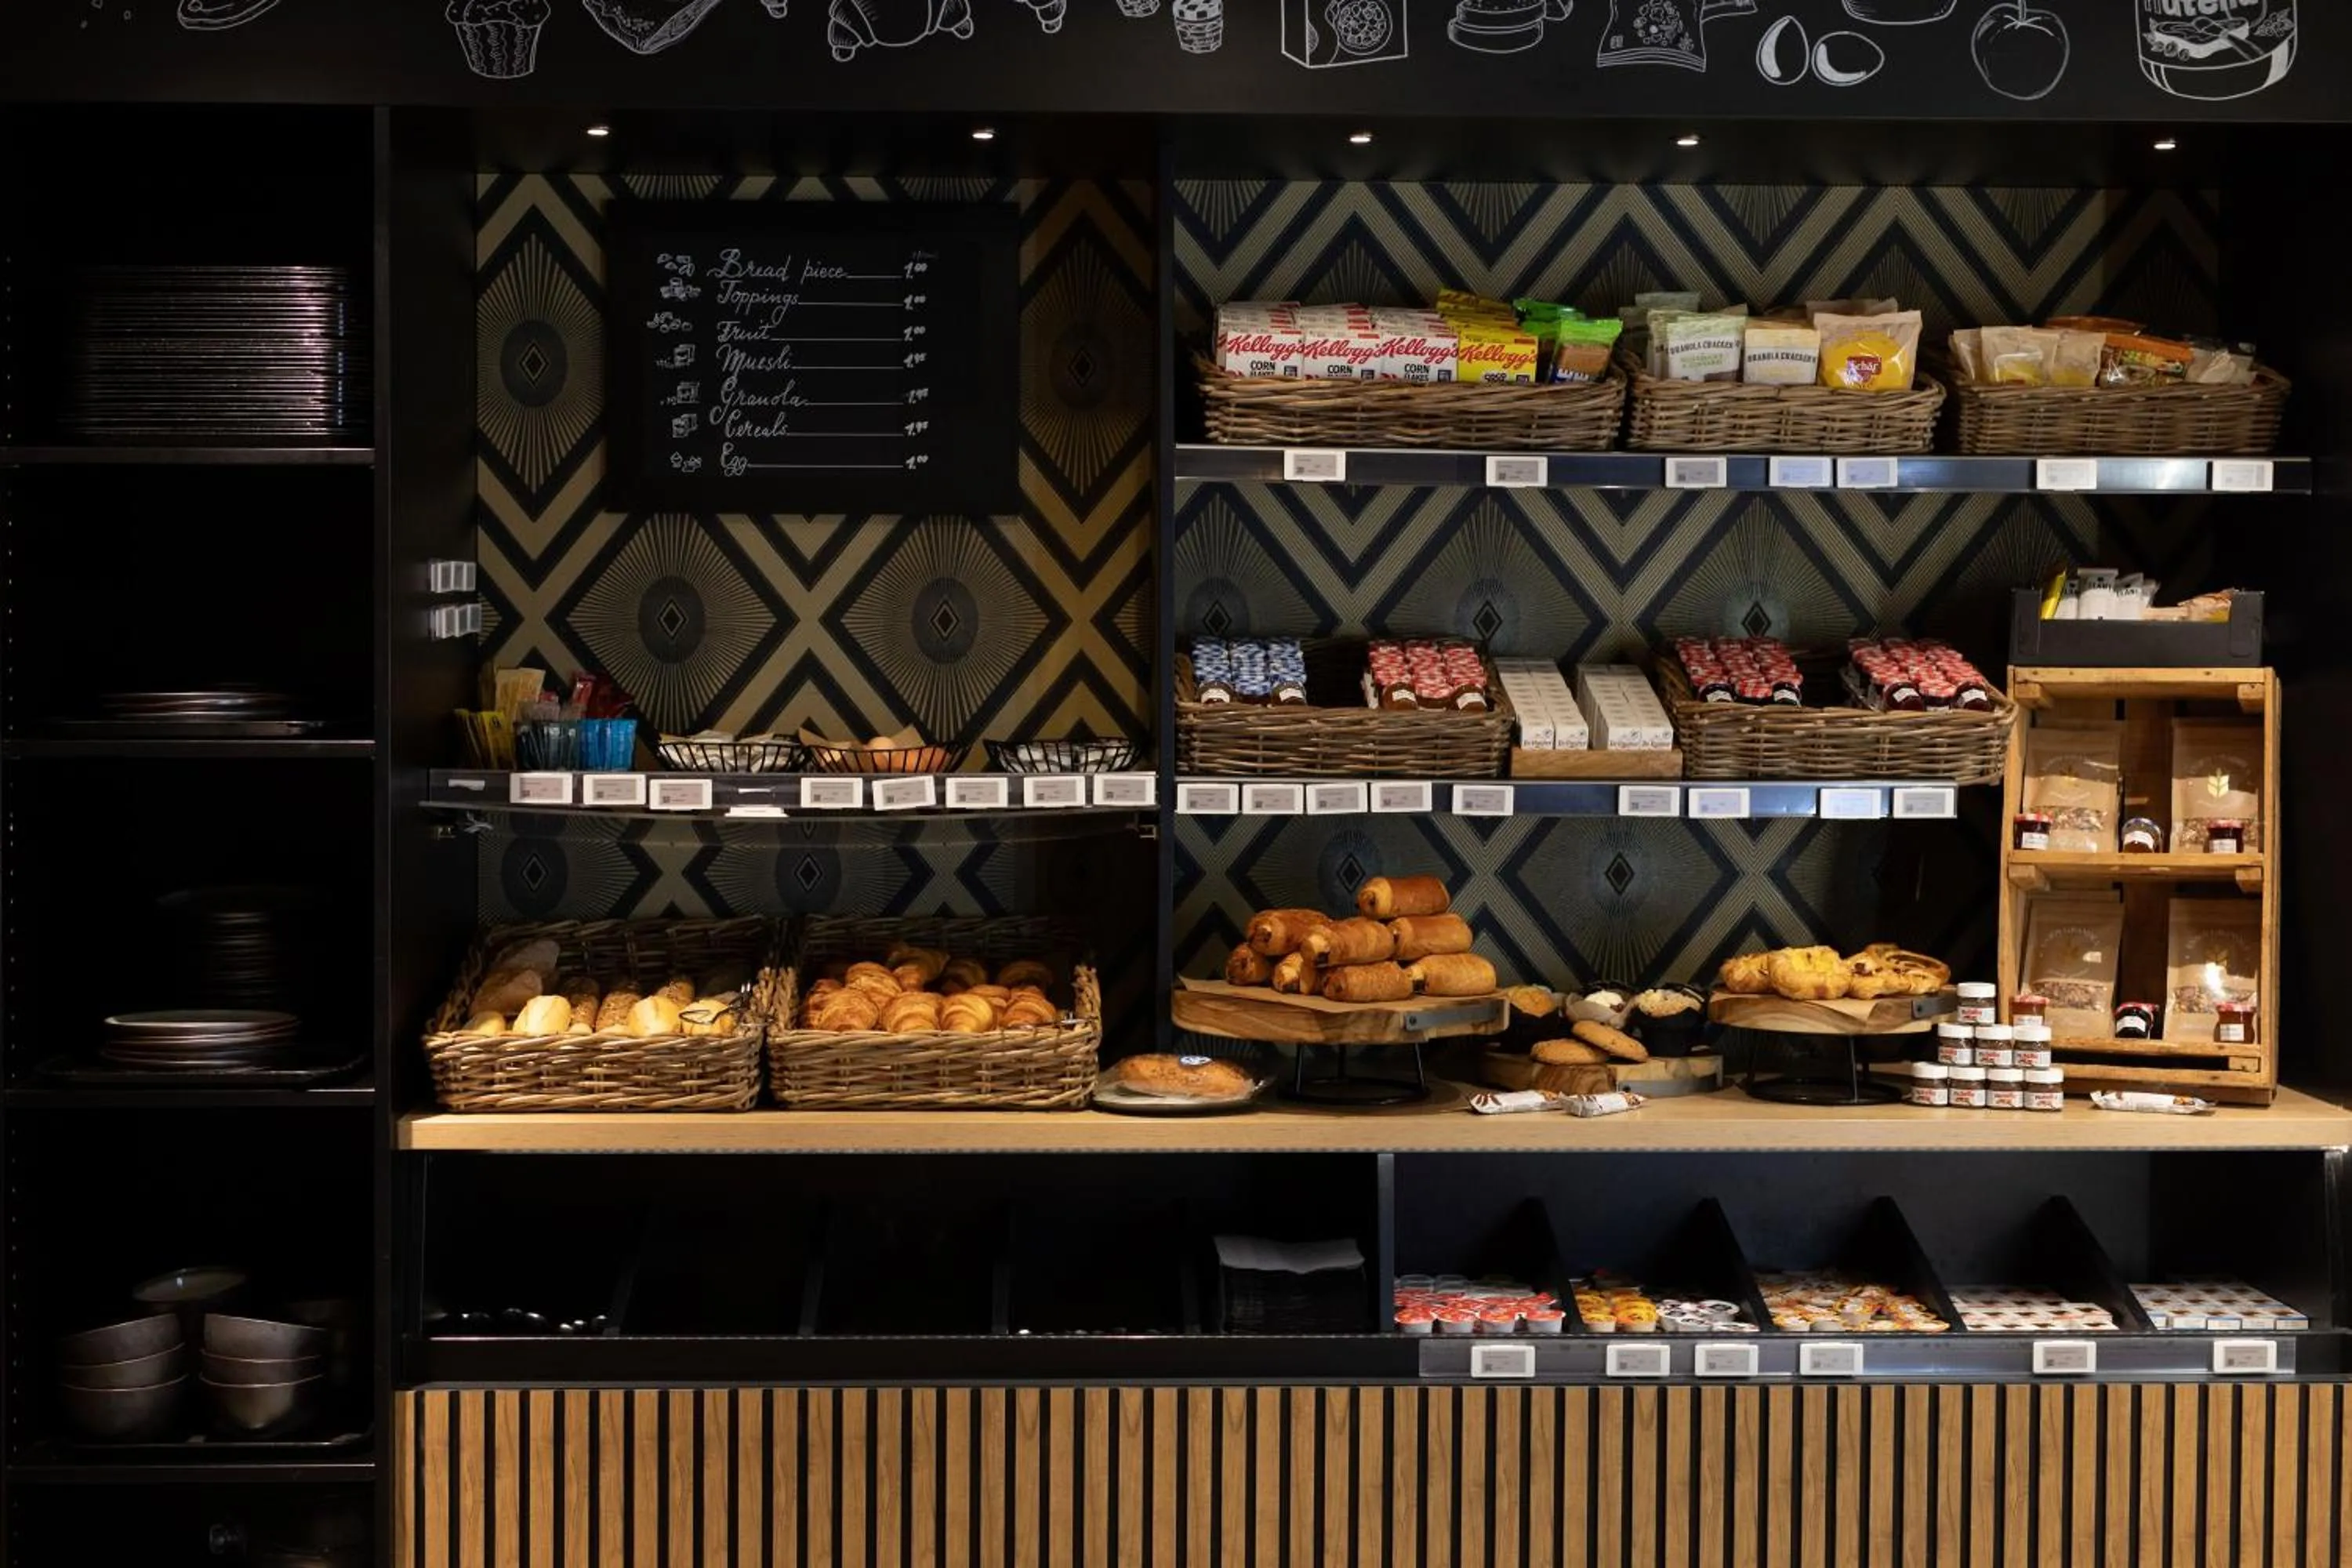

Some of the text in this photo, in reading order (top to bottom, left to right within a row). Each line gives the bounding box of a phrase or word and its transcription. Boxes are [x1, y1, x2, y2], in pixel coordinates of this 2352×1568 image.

[706, 248, 790, 281] Bread
[800, 258, 847, 284] piece
[717, 280, 798, 325] Toppings
[717, 319, 776, 343] Fruit
[716, 343, 791, 376] Muesli
[1228, 334, 1305, 361] Kellogg's
[1303, 339, 1381, 364] Kellogg's
[1381, 337, 1458, 364] Kellogg's
[1459, 343, 1537, 369] Kellogg's
[1250, 360, 1276, 370] CORN
[1327, 365, 1352, 374] CORN
[1404, 363, 1430, 373] CORN
[710, 375, 806, 426] Granola
[725, 408, 788, 439] Cereals
[720, 441, 748, 476] Egg
